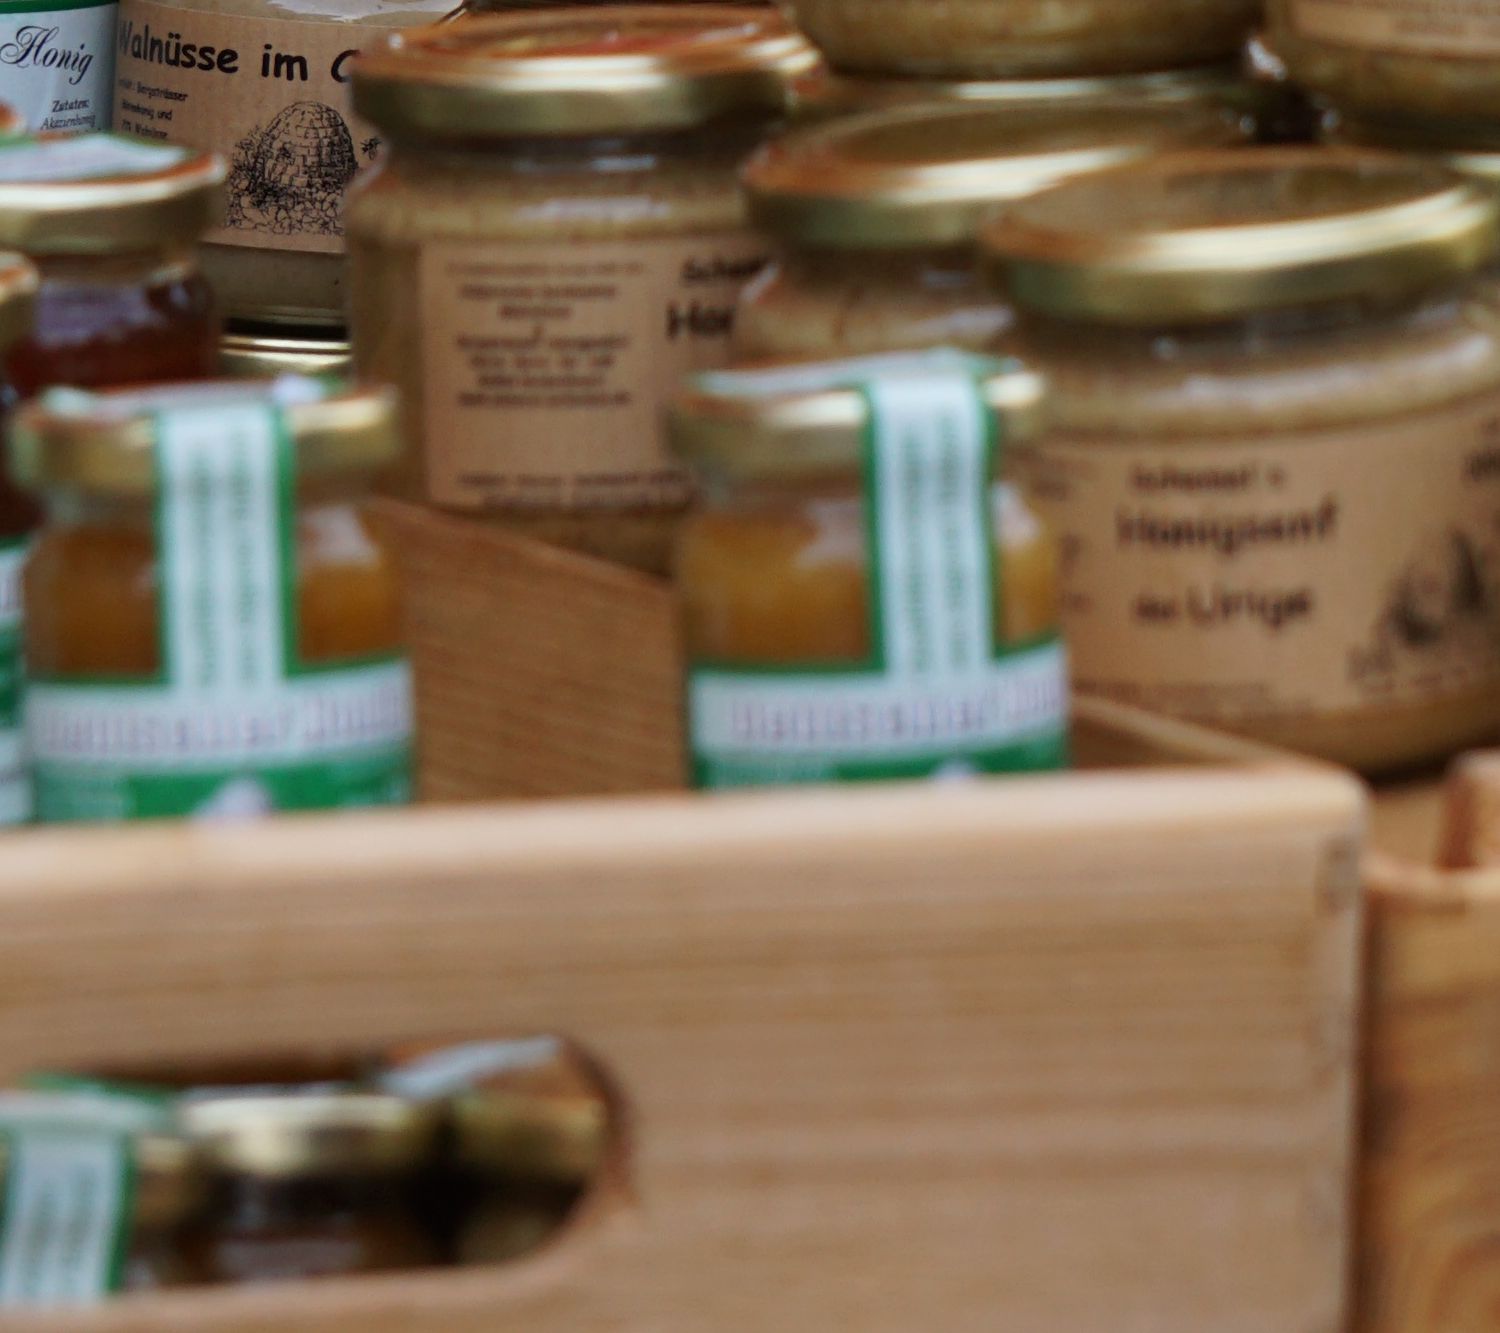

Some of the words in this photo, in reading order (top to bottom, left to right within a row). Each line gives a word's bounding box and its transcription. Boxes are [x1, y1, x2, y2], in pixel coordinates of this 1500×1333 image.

[119, 19, 238, 74] Walnüsse
[261, 43, 309, 81] im
[157, 108, 173, 121] und
[1115, 496, 1340, 553] Honigsenf
